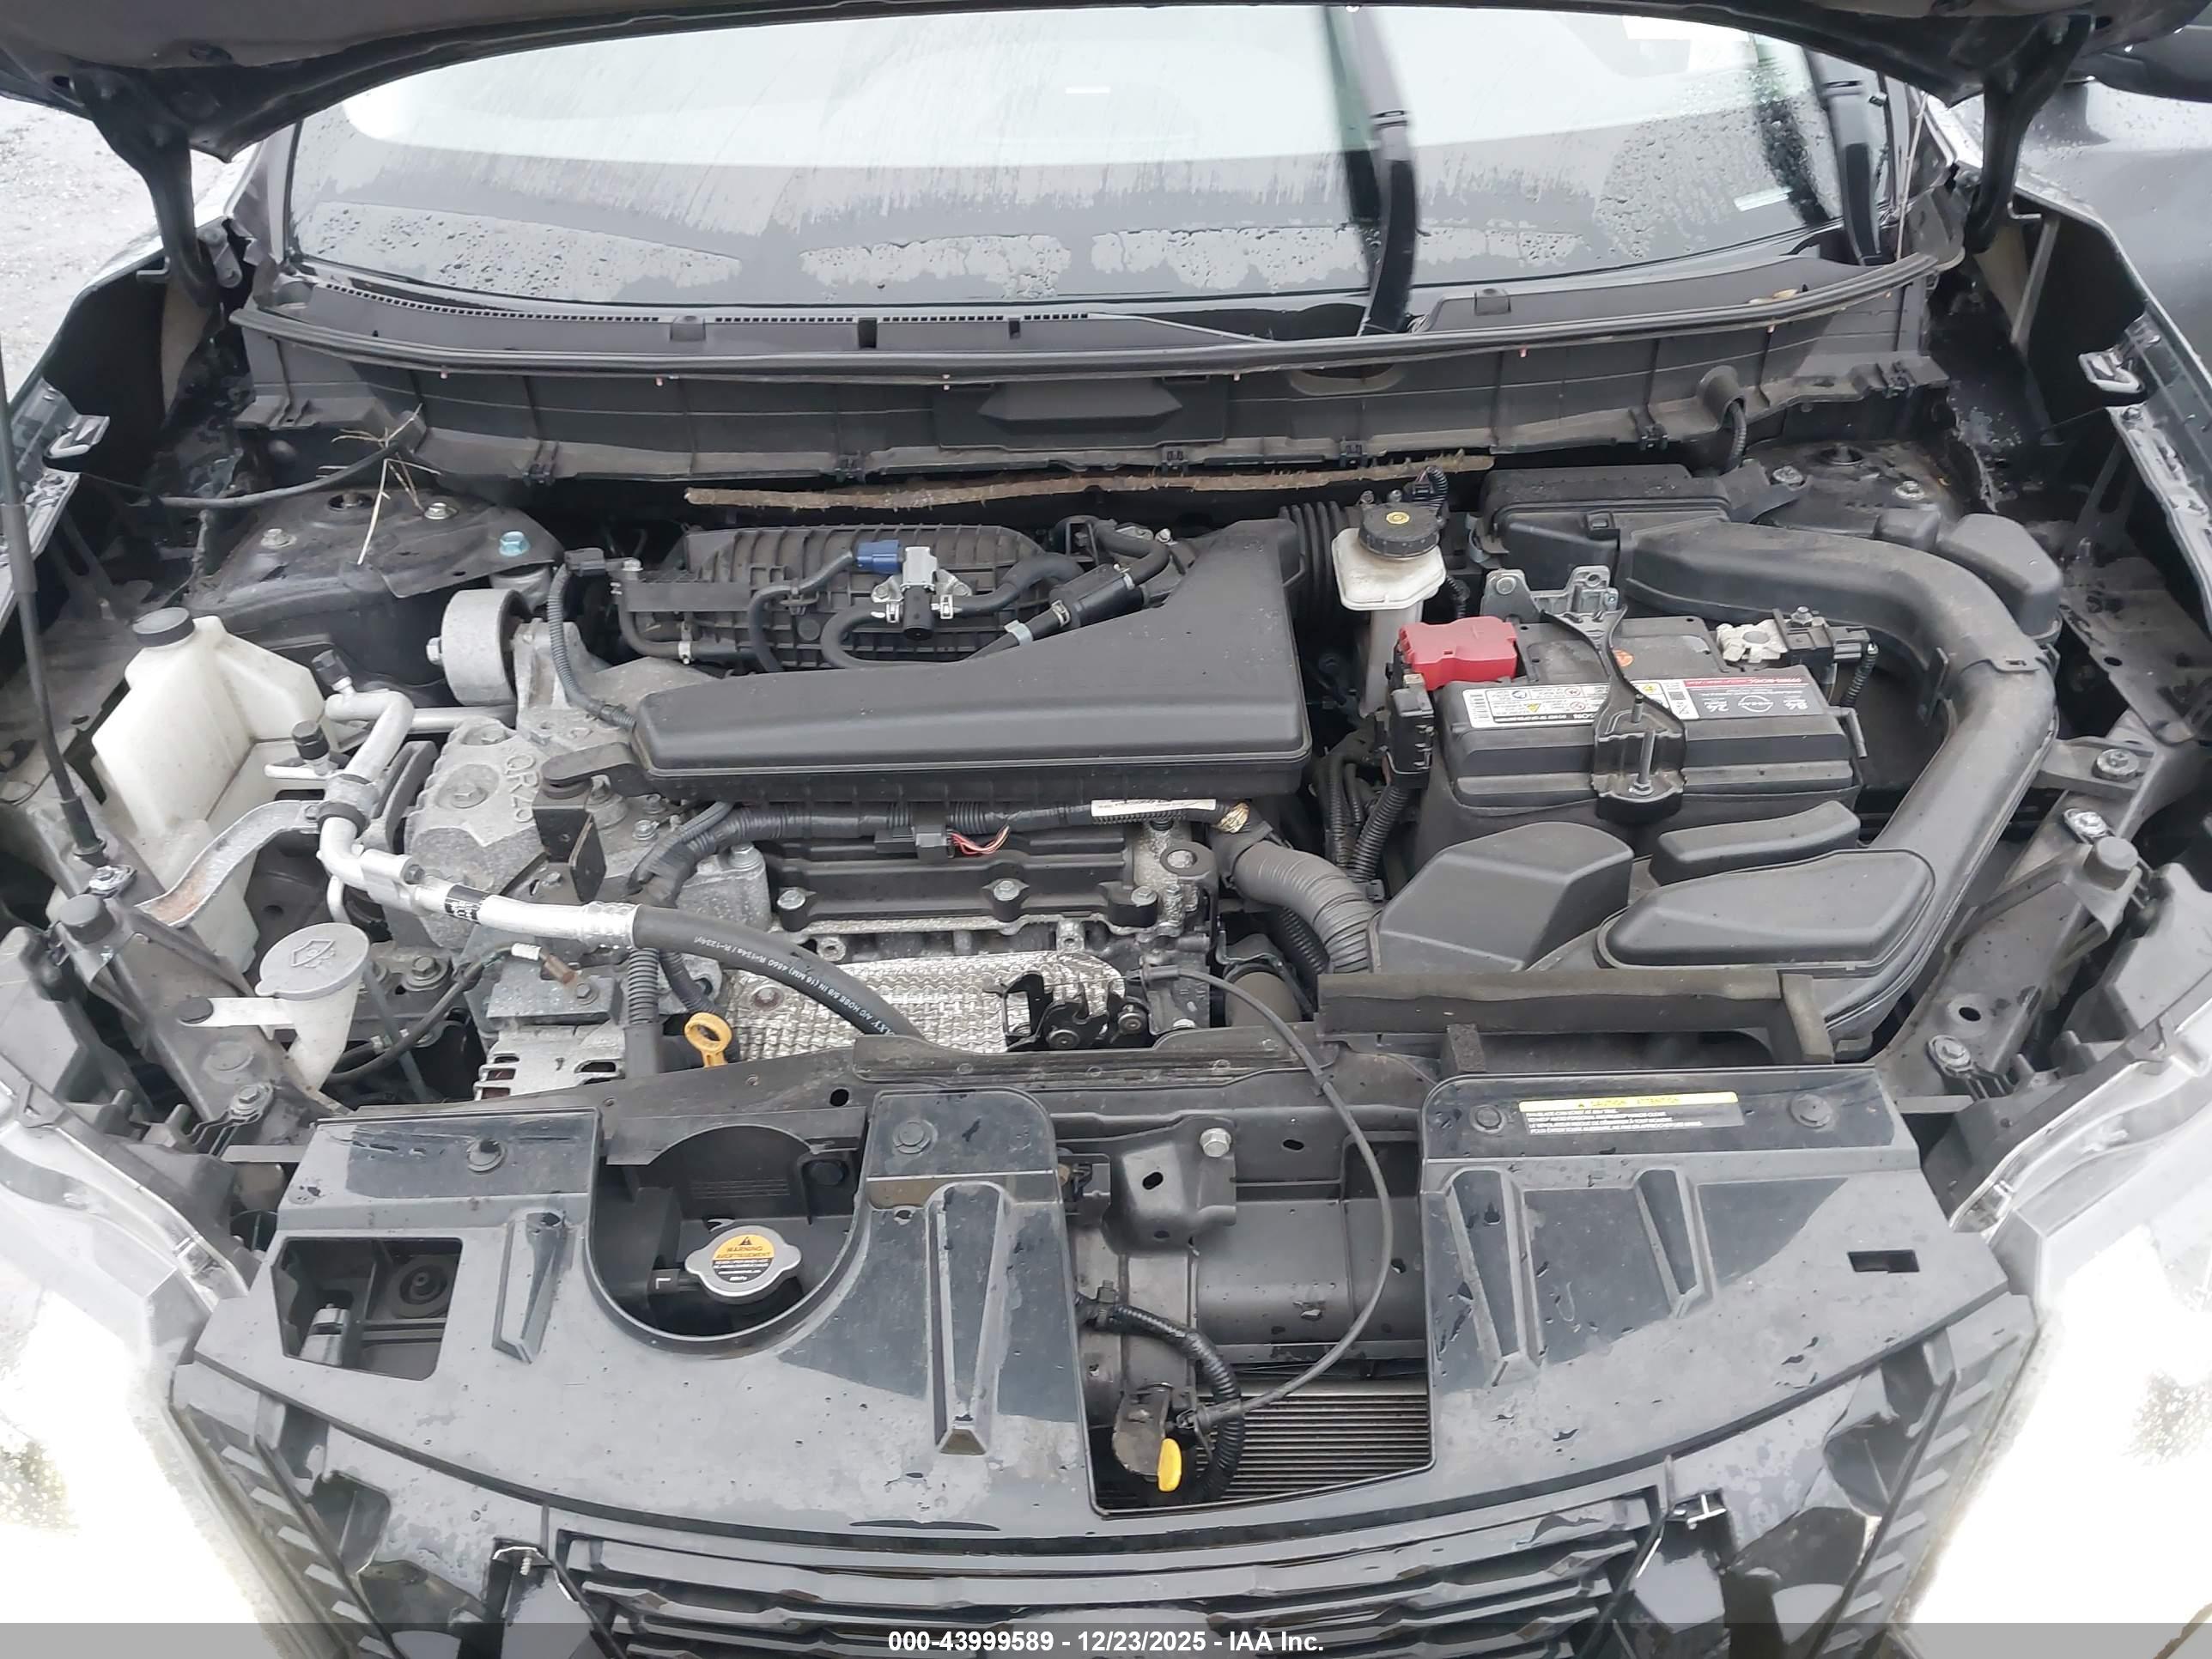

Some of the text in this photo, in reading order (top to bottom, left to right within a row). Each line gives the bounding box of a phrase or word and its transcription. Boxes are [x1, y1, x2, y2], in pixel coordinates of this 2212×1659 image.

[788, 967, 807, 981] MM)
[838, 995, 860, 1013] HOSE
[860, 1009, 873, 1020] A/C
